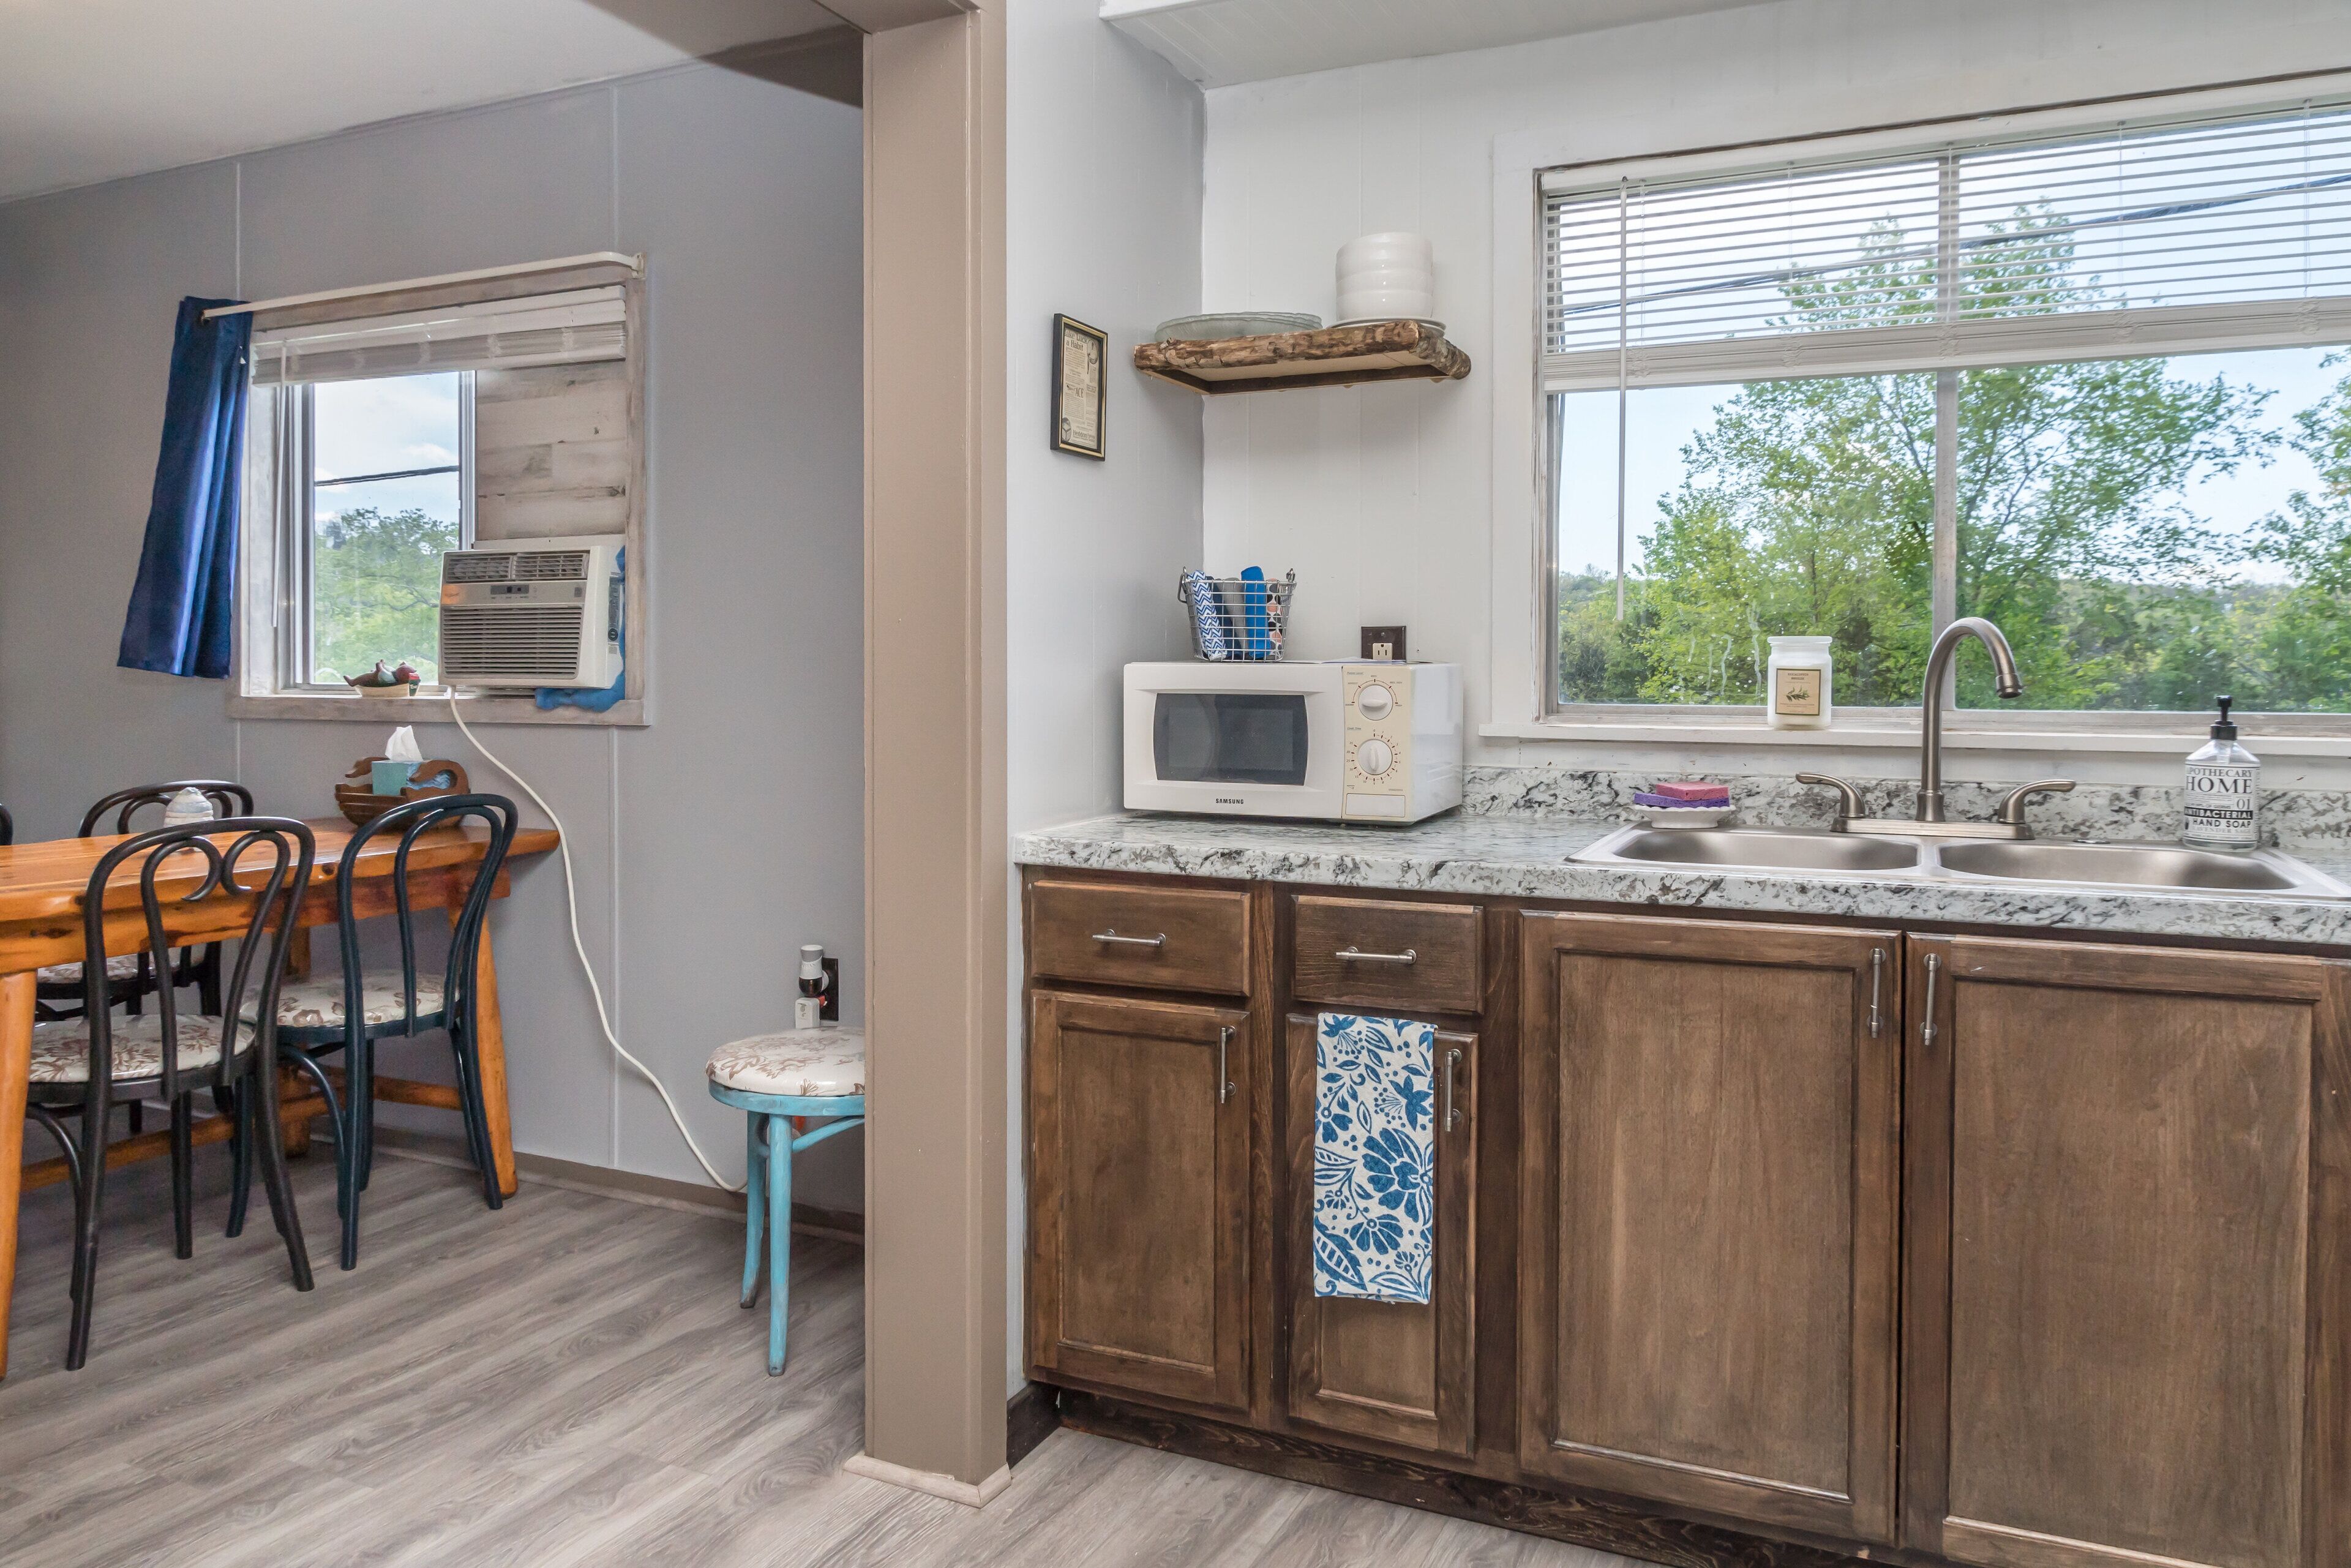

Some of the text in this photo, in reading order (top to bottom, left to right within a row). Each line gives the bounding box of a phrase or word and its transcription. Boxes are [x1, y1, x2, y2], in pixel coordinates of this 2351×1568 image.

[2188, 767, 2253, 777] POTHECARY
[2186, 776, 2252, 793] HOME
[2237, 798, 2251, 809] 01
[2185, 808, 2251, 819] ANTIBACTERIAL
[2192, 818, 2221, 827] HAND
